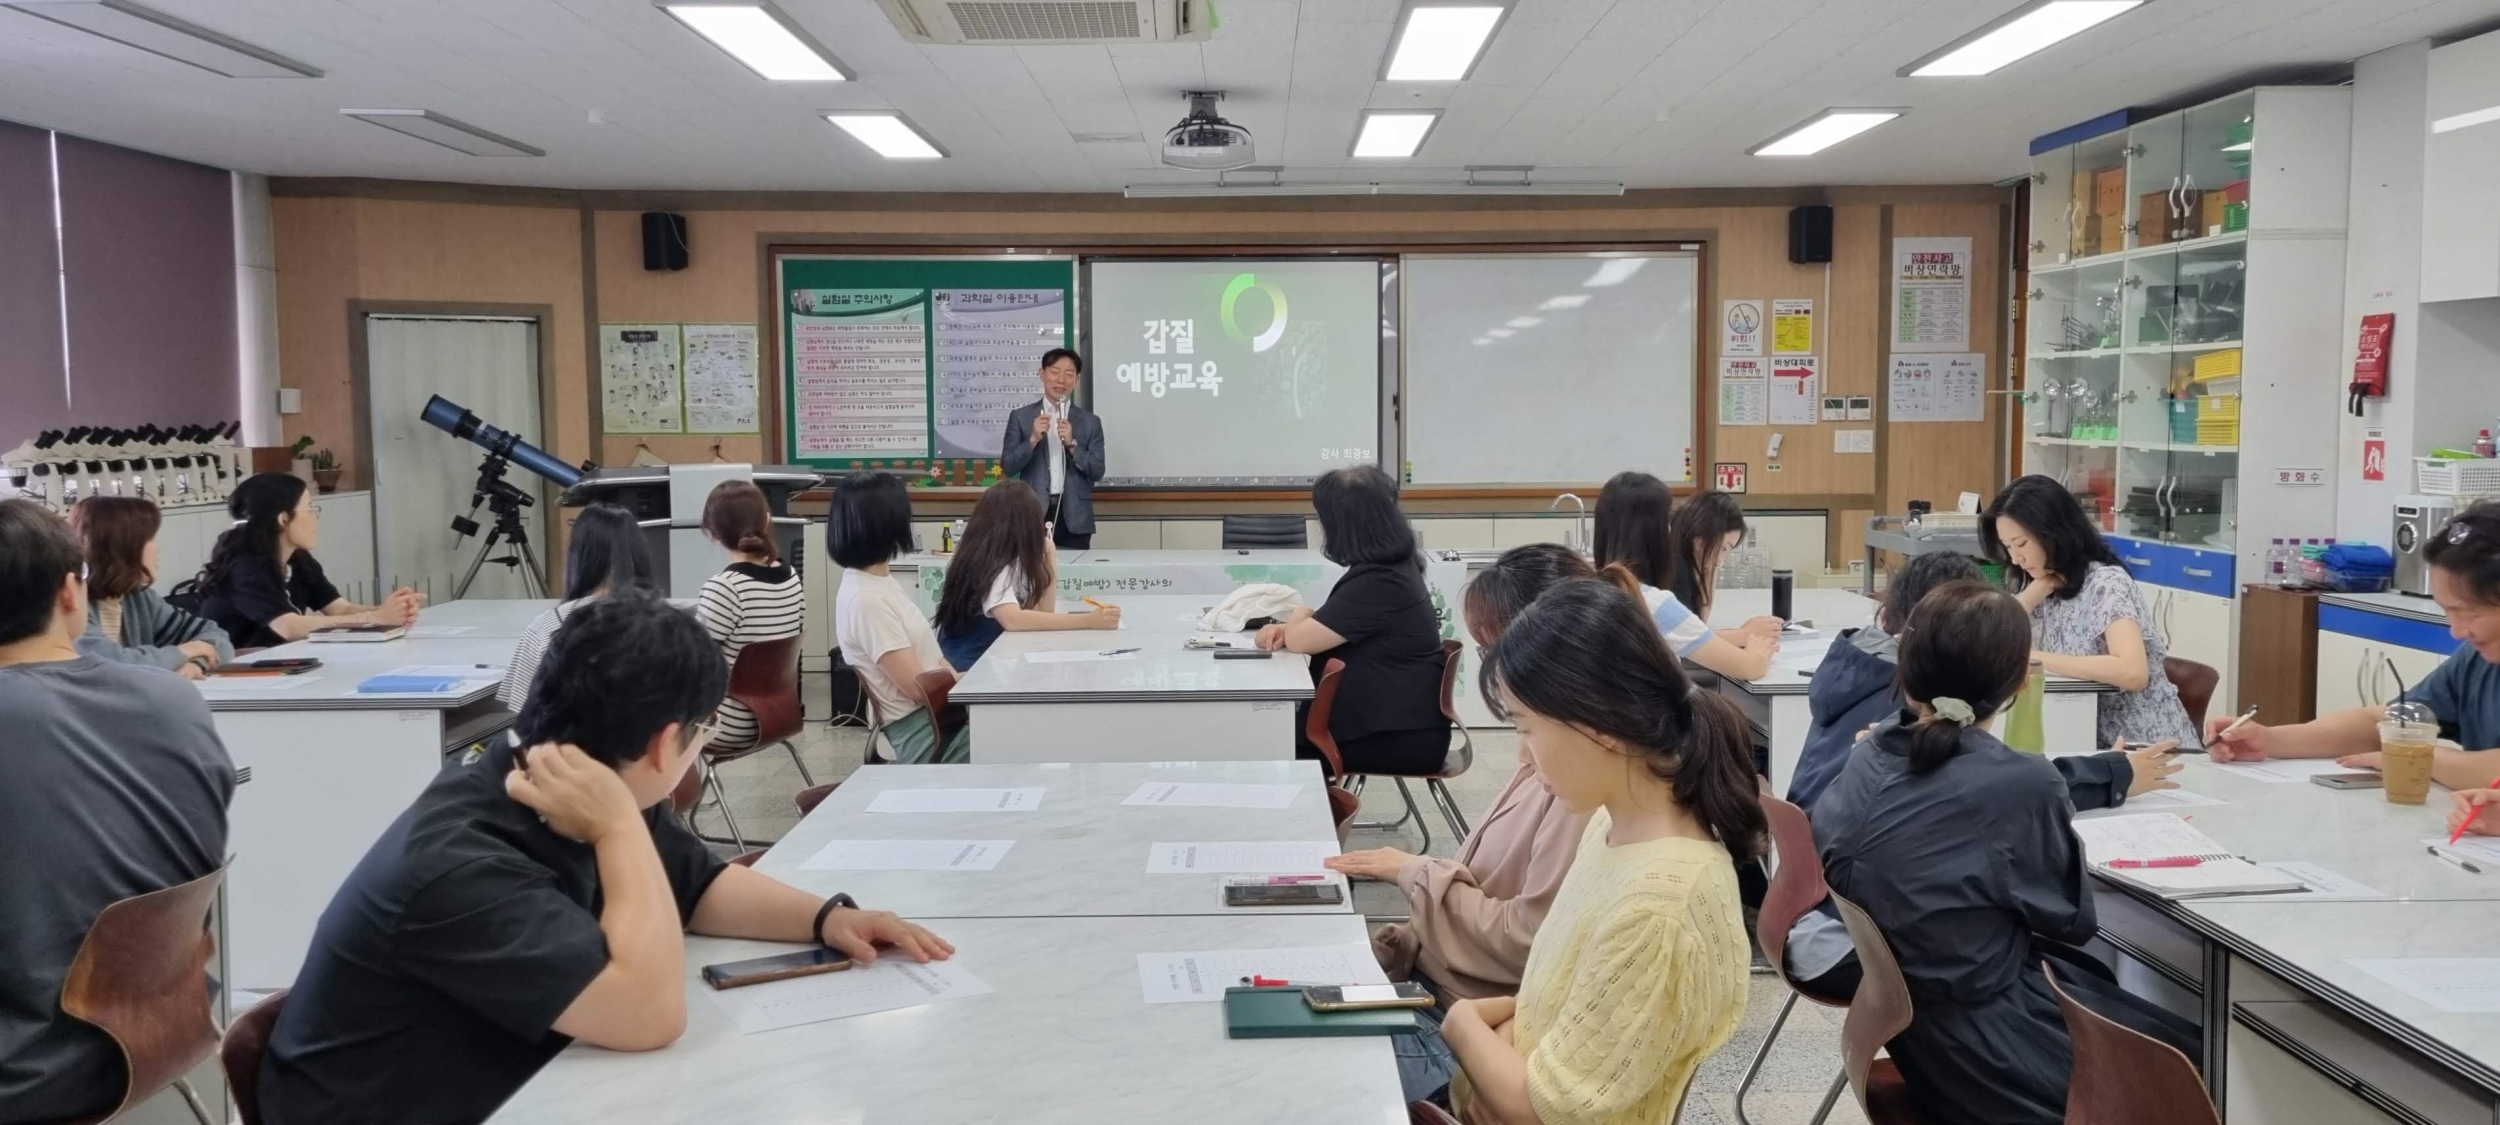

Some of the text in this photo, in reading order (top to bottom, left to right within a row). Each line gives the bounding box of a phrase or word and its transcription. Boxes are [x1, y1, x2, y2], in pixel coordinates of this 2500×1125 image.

[1912, 253, 1953, 263] 안전사고
[1904, 264, 1961, 275] 비상연락망
[822, 294, 893, 304] 실험실 주의사항
[961, 293, 1039, 303] 과학실 이용안내
[1143, 319, 1195, 354] 갑질
[1774, 359, 1814, 367] 비상대피로
[1116, 360, 1223, 398] 예방교육
[1321, 448, 1371, 460] 강사 최광보
[2279, 471, 2320, 482] 방화수
[1116, 577, 1172, 590] 전문강사의
